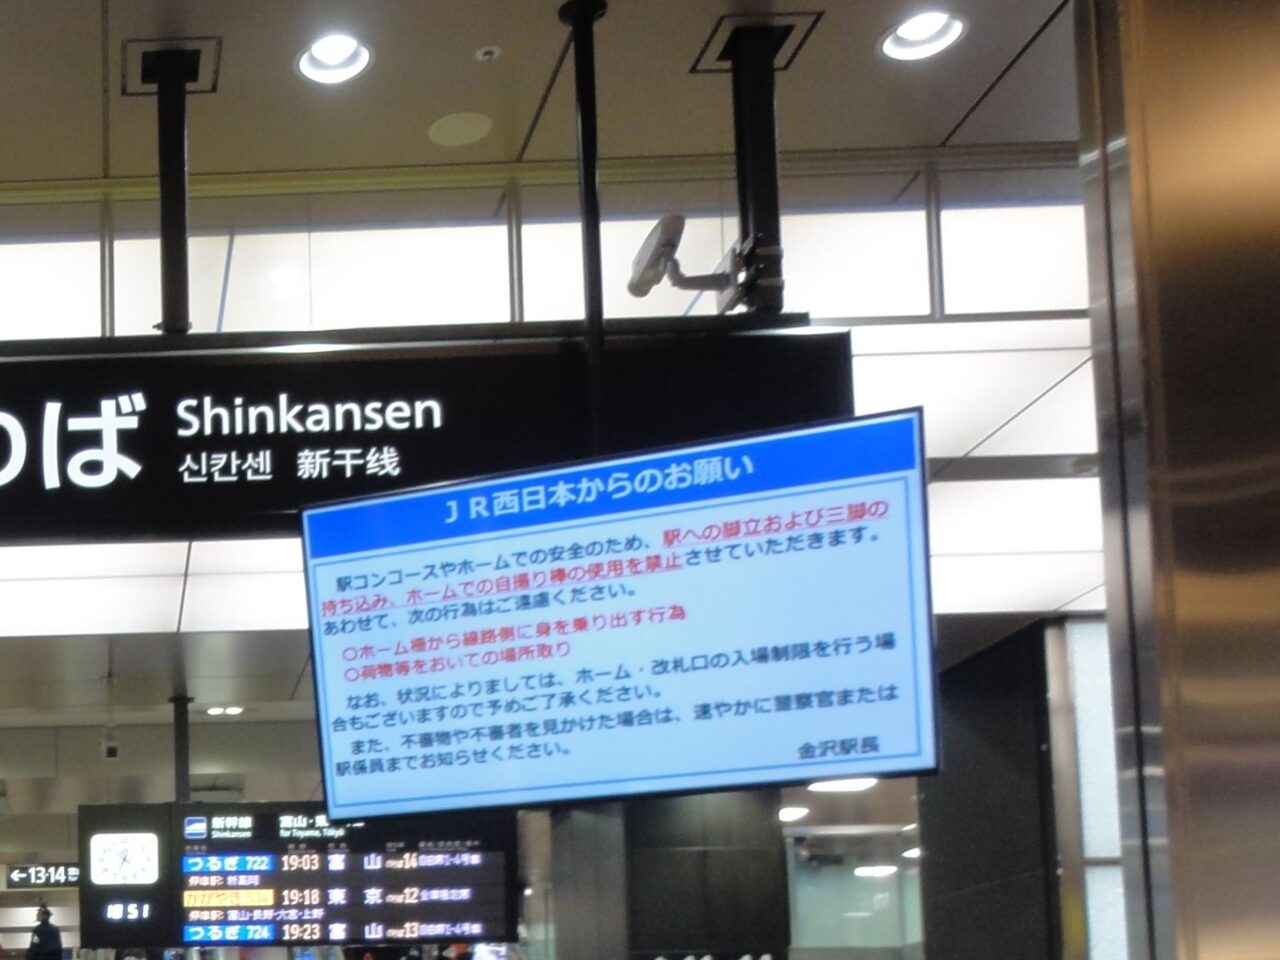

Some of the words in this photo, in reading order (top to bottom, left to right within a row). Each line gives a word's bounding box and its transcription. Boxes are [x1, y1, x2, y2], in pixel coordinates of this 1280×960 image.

[175, 394, 443, 440] Shinkansen
[177, 446, 273, 484] 신칸센
[297, 444, 401, 481] 新干线
[798, 735, 880, 760] 金沢駅長
[188, 856, 239, 871] つるぎ
[246, 856, 270, 871] 722
[281, 854, 320, 871] 19:03
[282, 889, 321, 906] 19:18
[189, 925, 239, 940] つるぎ
[246, 924, 270, 940] 724
[282, 923, 321, 940] 19:23
